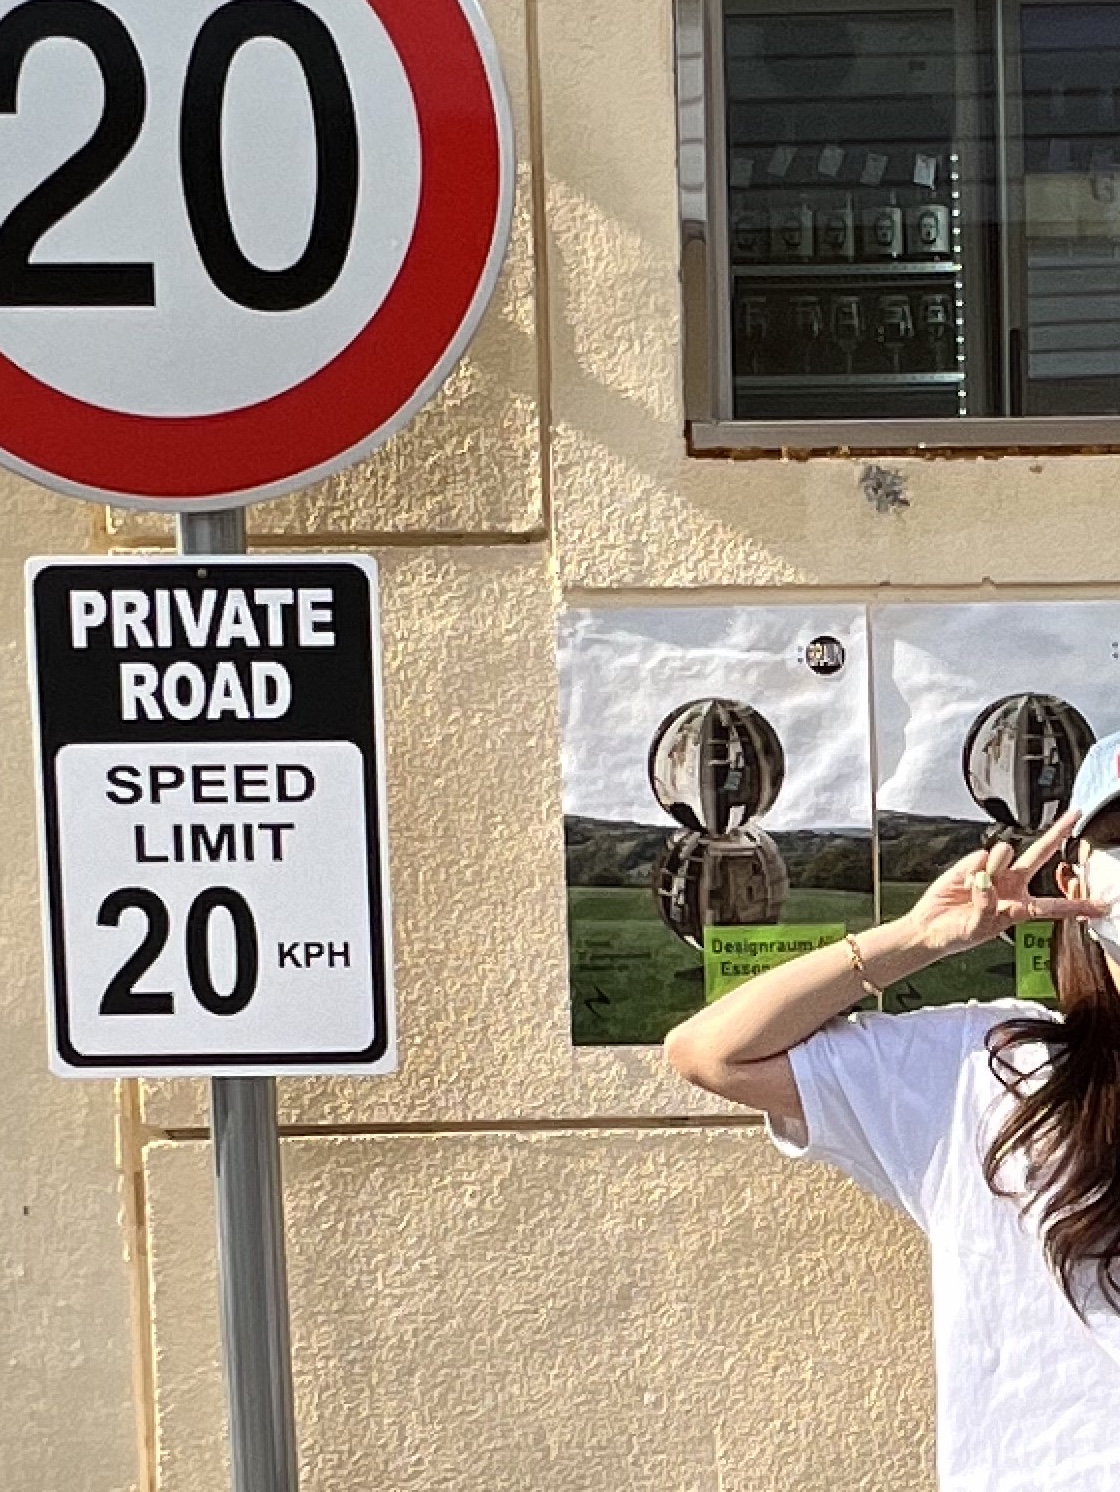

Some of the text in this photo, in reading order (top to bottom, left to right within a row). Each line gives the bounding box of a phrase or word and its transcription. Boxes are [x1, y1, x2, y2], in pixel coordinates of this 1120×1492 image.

[0, 0, 359, 312] 20
[69, 588, 337, 649] PRIVATE
[119, 661, 293, 721] ROAD
[105, 763, 316, 805] SPEED
[133, 822, 295, 863] LIMIT
[96, 885, 351, 1017] 20 KPH
[711, 939, 814, 956] Designraum
